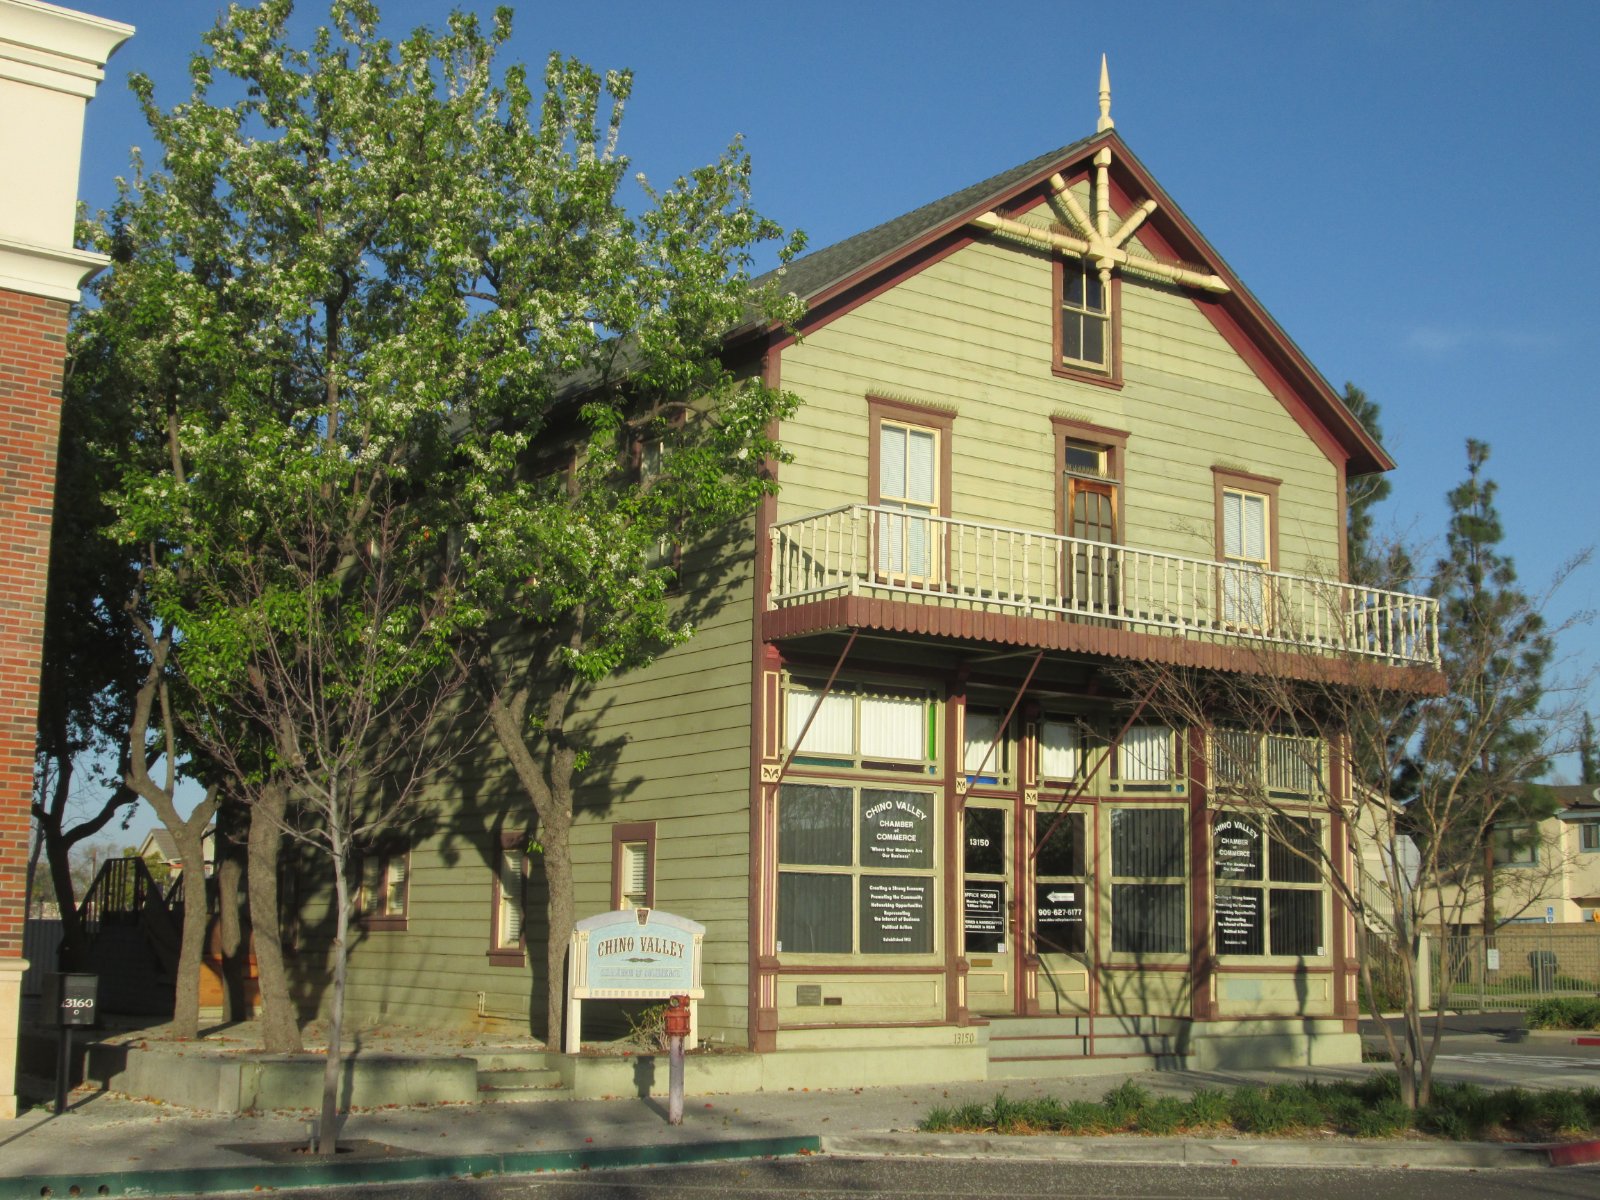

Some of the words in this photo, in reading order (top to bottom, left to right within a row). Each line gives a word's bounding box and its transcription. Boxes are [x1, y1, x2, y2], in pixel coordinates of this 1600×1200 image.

[866, 801, 892, 819] CHINO
[896, 801, 927, 820] VALLEY
[880, 820, 913, 828] CHAMBER
[1234, 821, 1259, 839] VALLEY
[877, 833, 916, 841] COMMERCE
[970, 838, 989, 847] 13150
[1219, 849, 1250, 857] COMMERCE
[598, 937, 634, 957] CHINO
[640, 937, 684, 958] VALLEY
[955, 1032, 974, 1045] 13150
